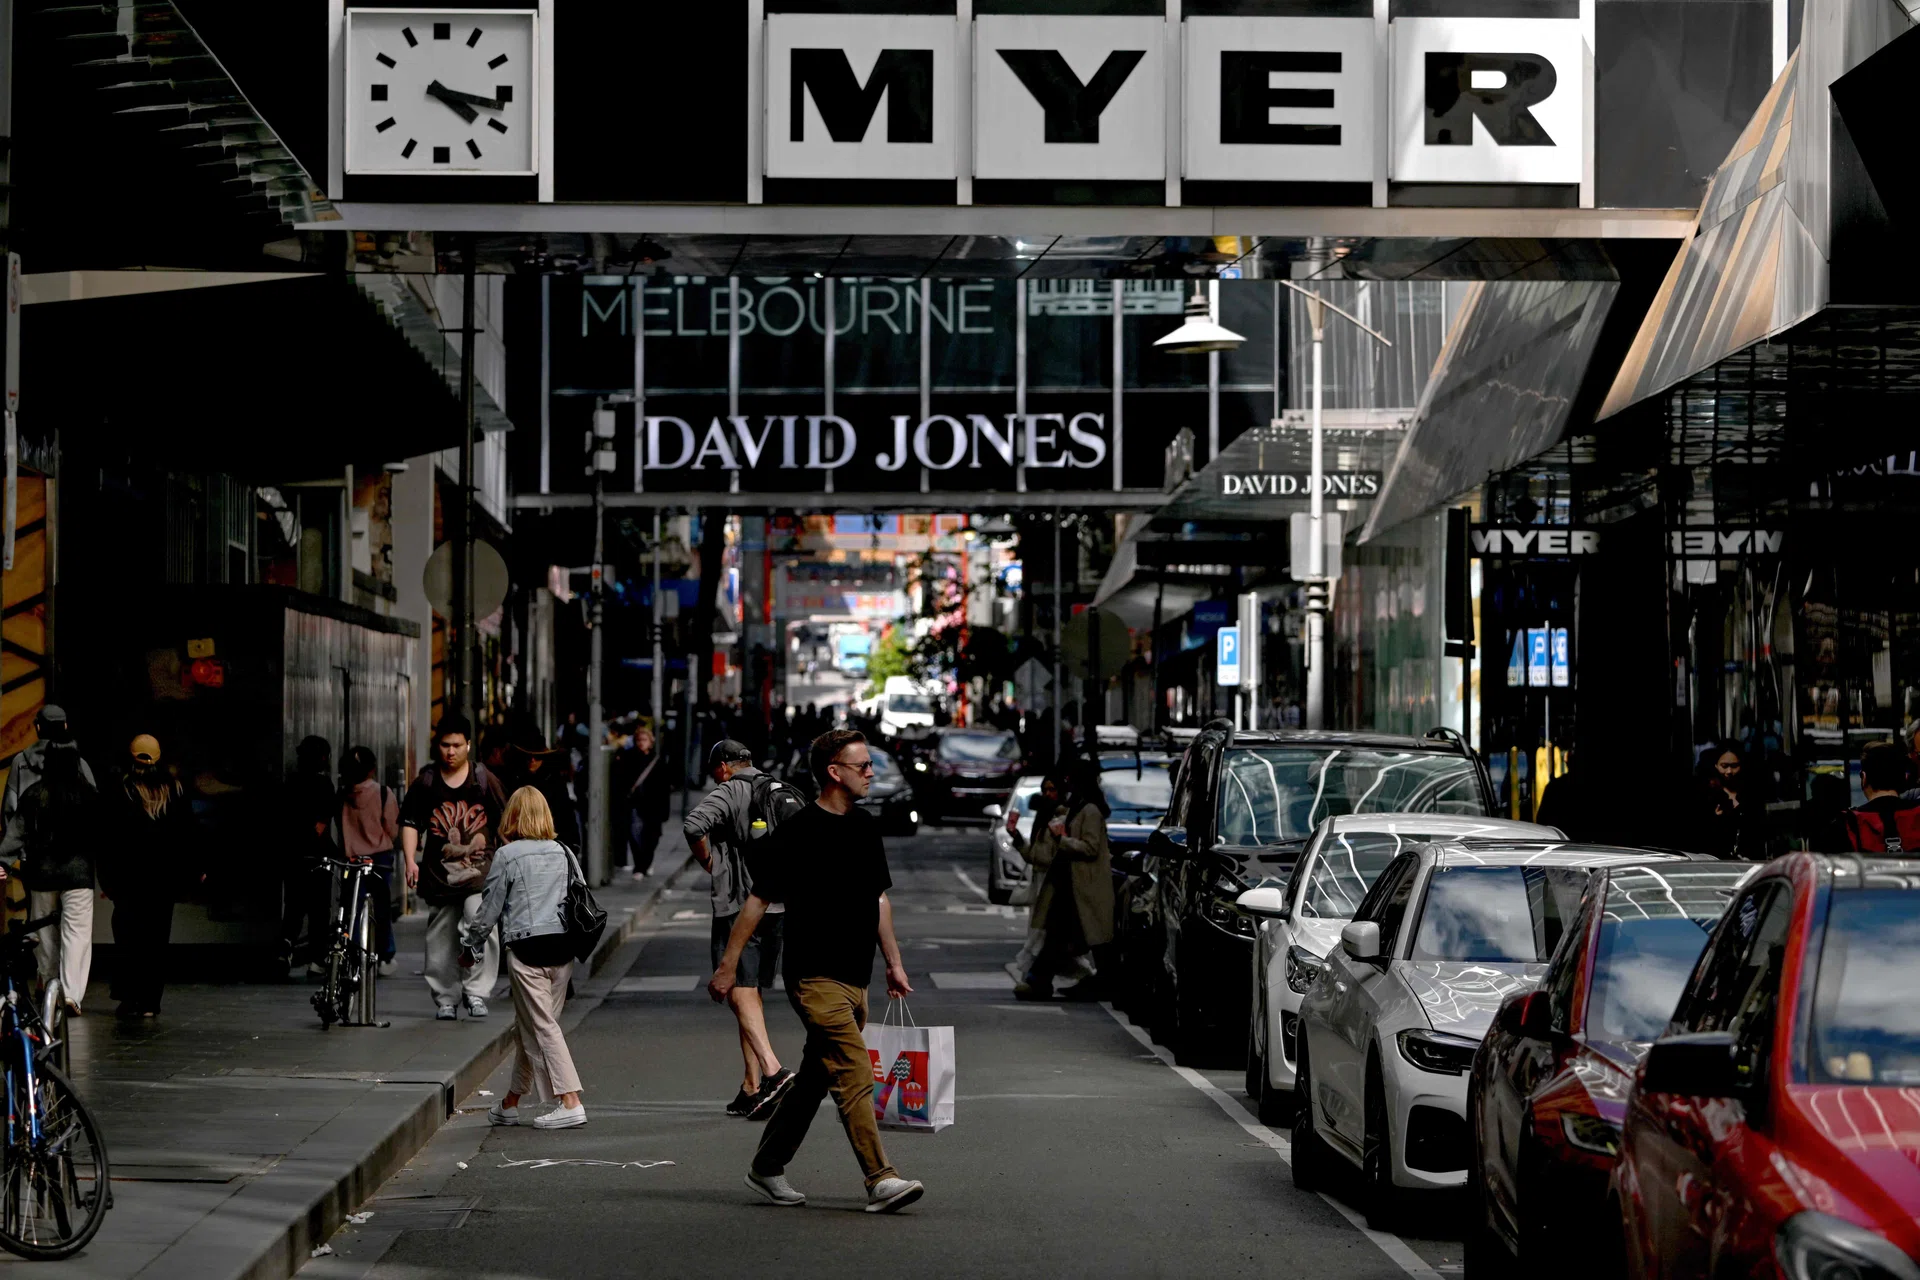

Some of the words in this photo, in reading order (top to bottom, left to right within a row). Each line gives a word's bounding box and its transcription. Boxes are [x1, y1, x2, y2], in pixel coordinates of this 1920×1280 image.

[790, 49, 1558, 146] MYER
[582, 285, 996, 337] MELBOURNE
[644, 414, 857, 471] DAVID
[874, 411, 1107, 471] JONES
[1222, 474, 1298, 495] DAVID
[1471, 529, 1600, 555] MYER
[1223, 635, 1235, 662] P
